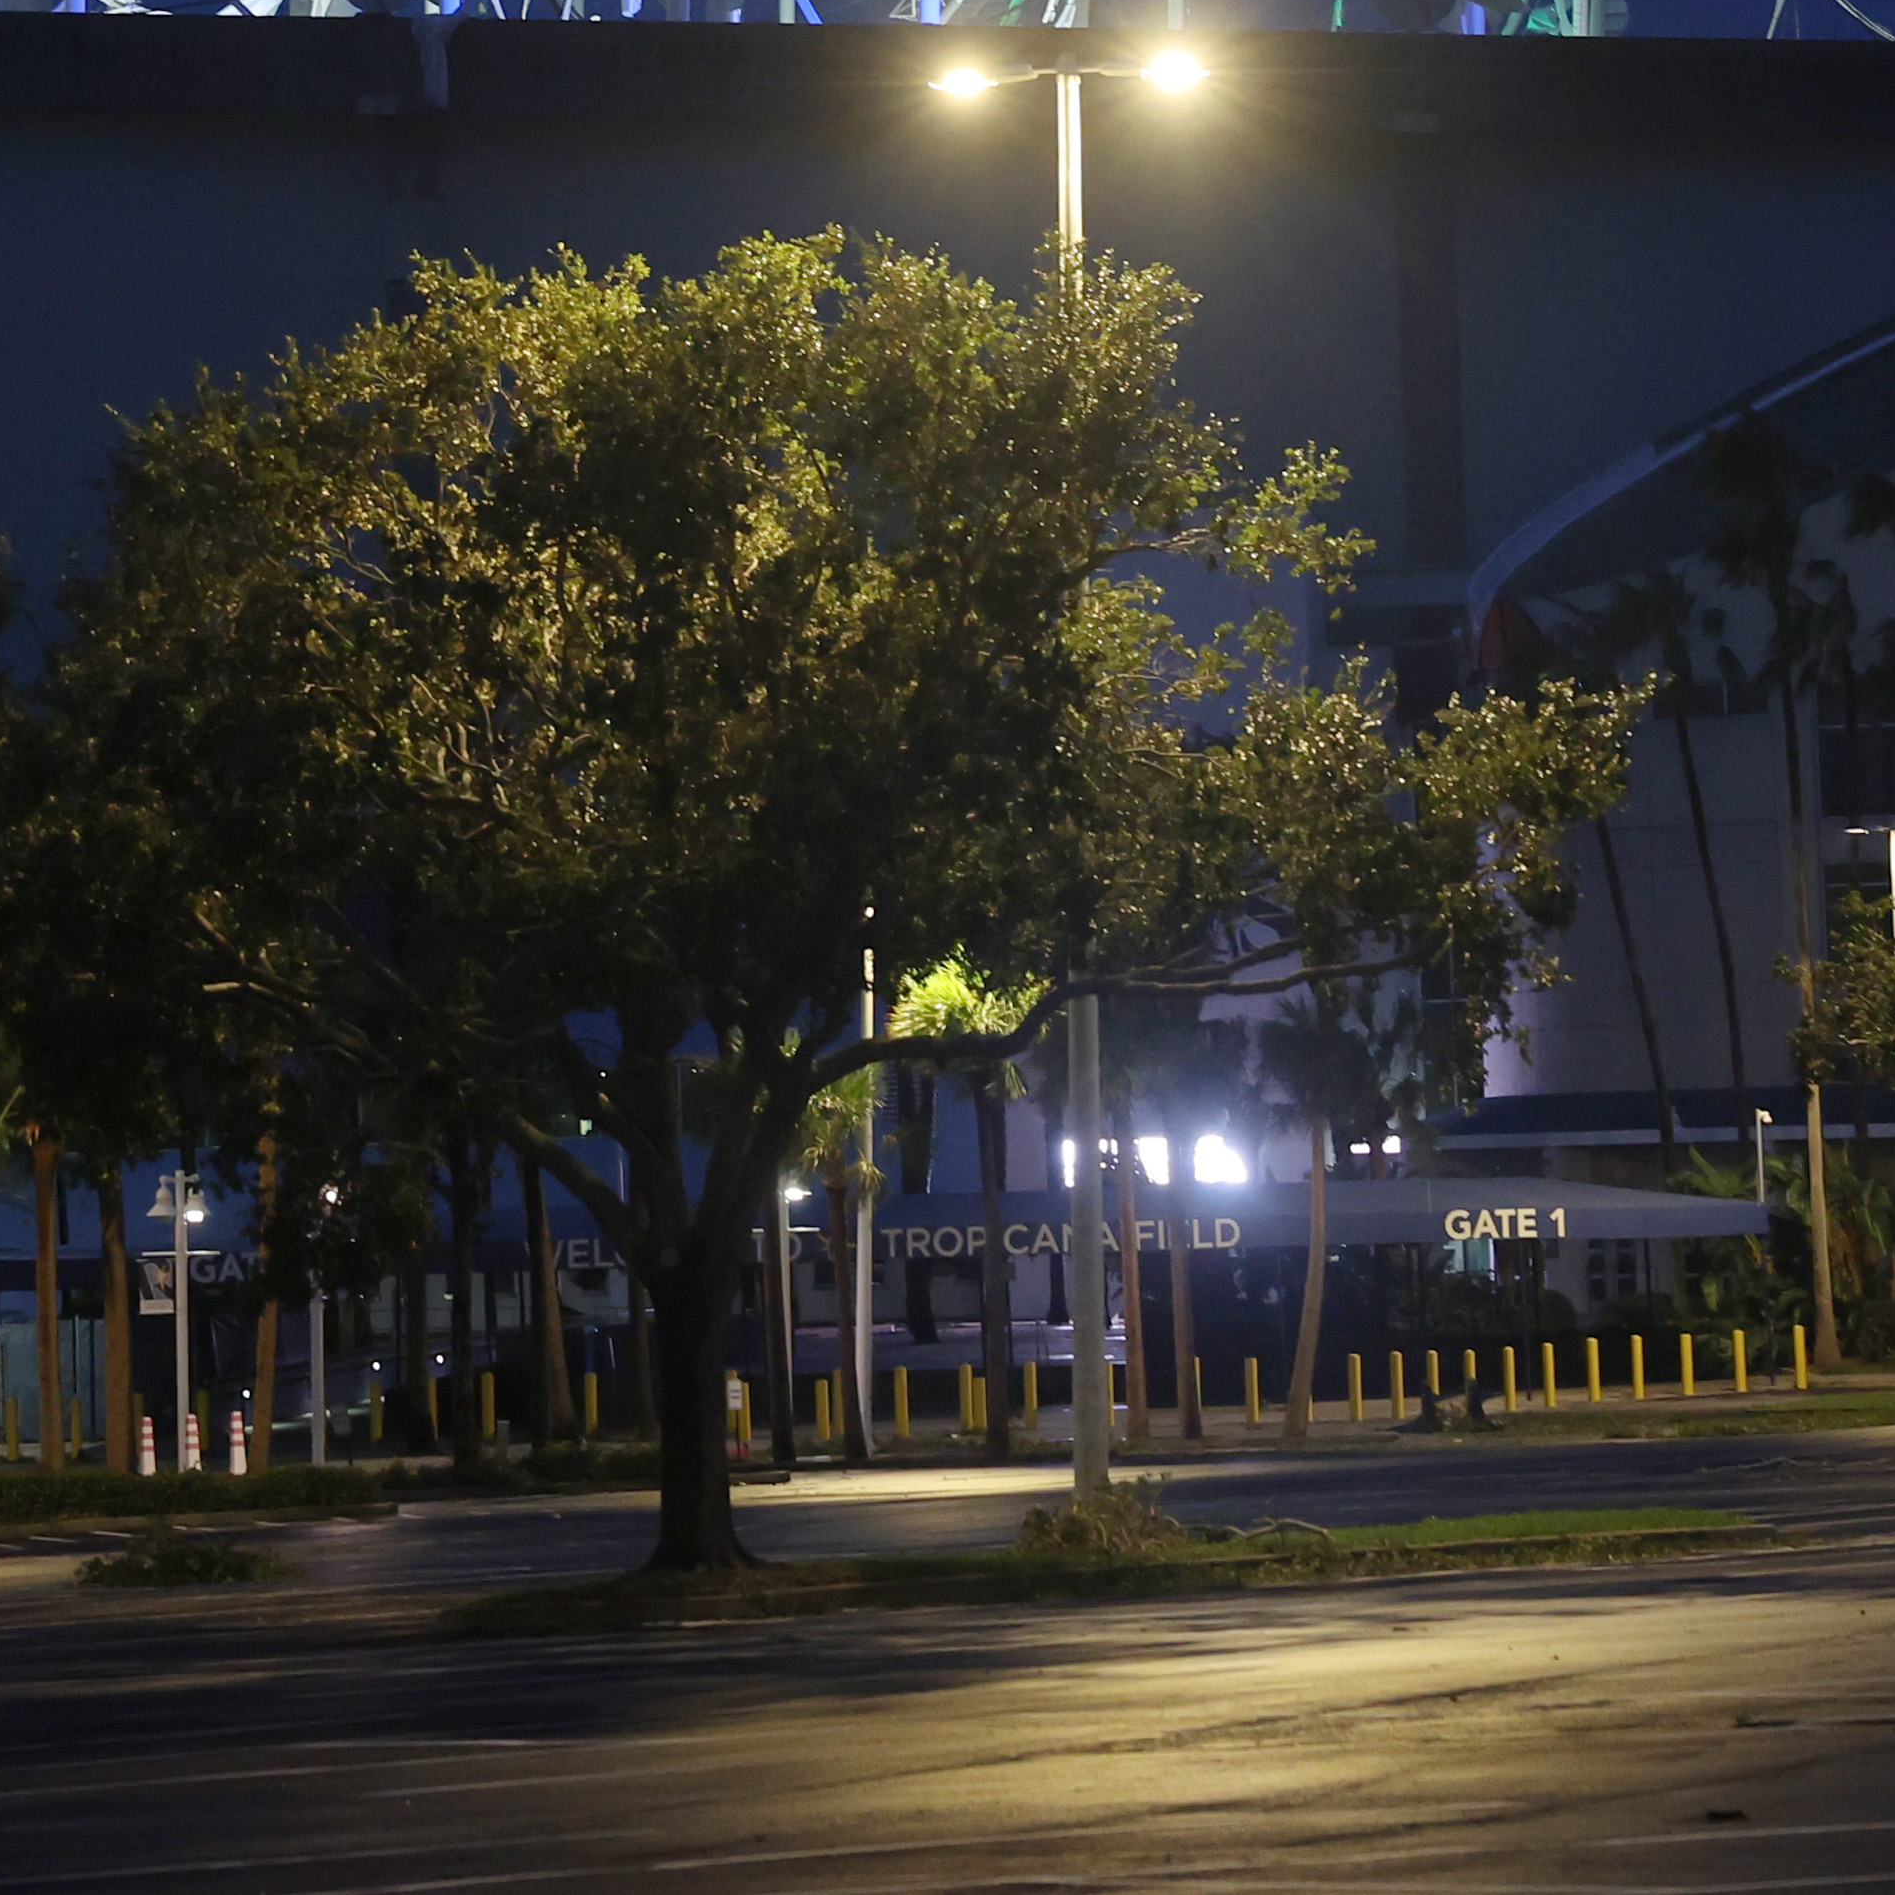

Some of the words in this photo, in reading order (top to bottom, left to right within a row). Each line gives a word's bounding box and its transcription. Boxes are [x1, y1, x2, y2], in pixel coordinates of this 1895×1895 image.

[879, 1222, 1121, 1258] TROPCAA
[1135, 1217, 1241, 1251] FILD
[1444, 1207, 1539, 1240] GATE
[1549, 1207, 1566, 1238] 1
[189, 1252, 263, 1284] GAT
